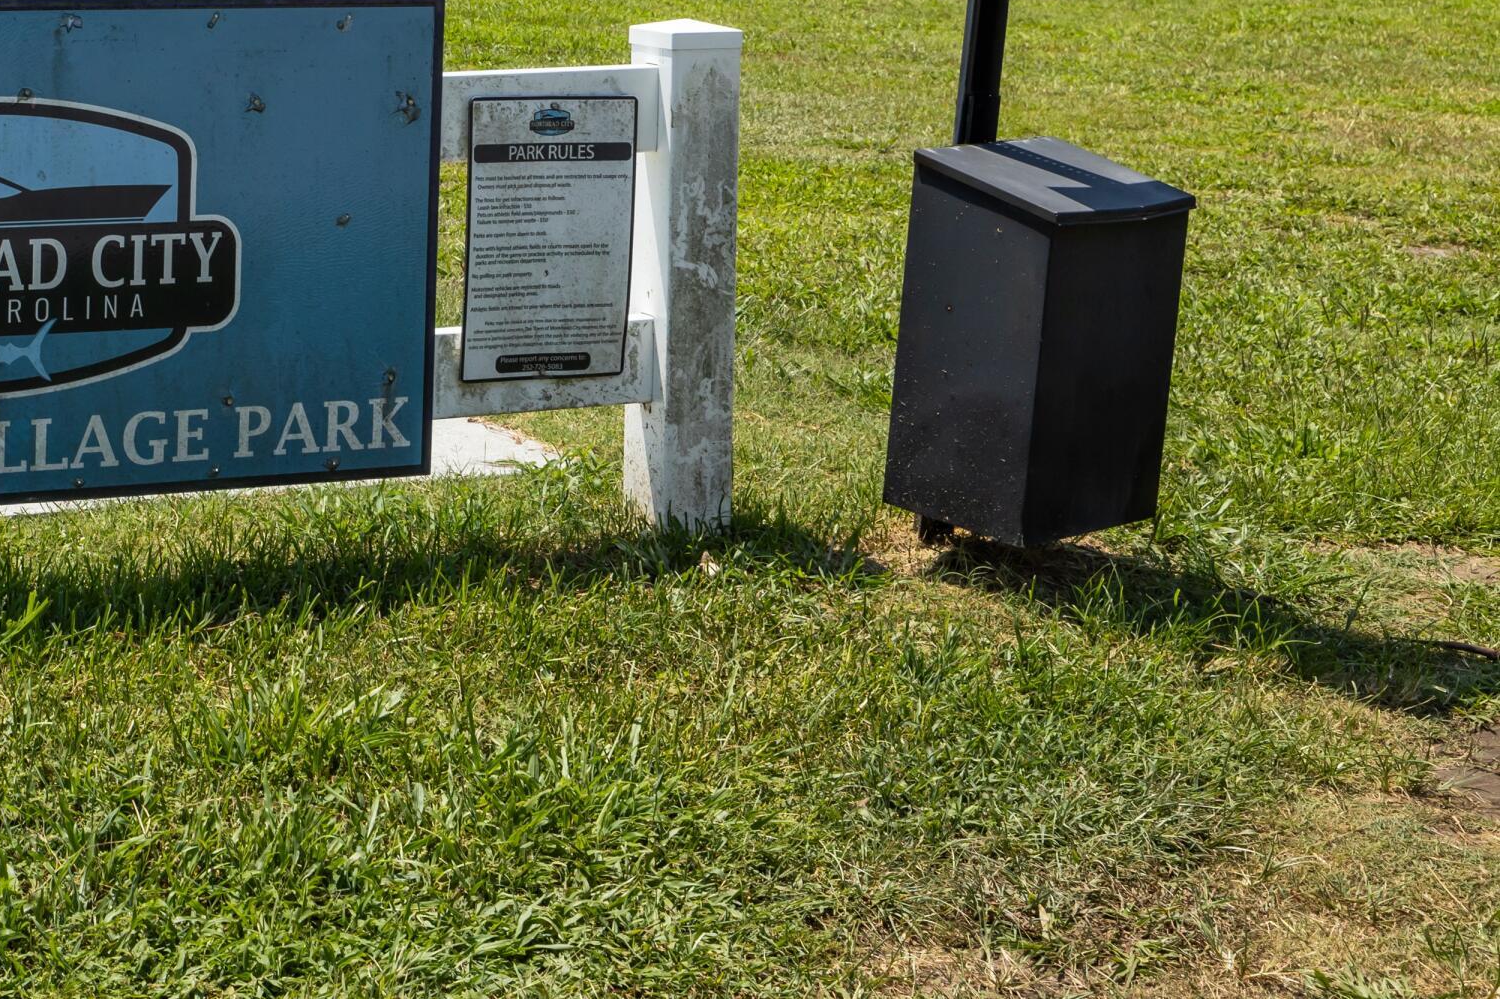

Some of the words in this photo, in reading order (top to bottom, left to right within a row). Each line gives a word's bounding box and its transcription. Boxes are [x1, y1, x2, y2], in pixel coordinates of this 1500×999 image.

[509, 145, 544, 160] PARK
[549, 145, 594, 159] RULES
[91, 232, 222, 287] CITY
[233, 396, 411, 458] PARK
